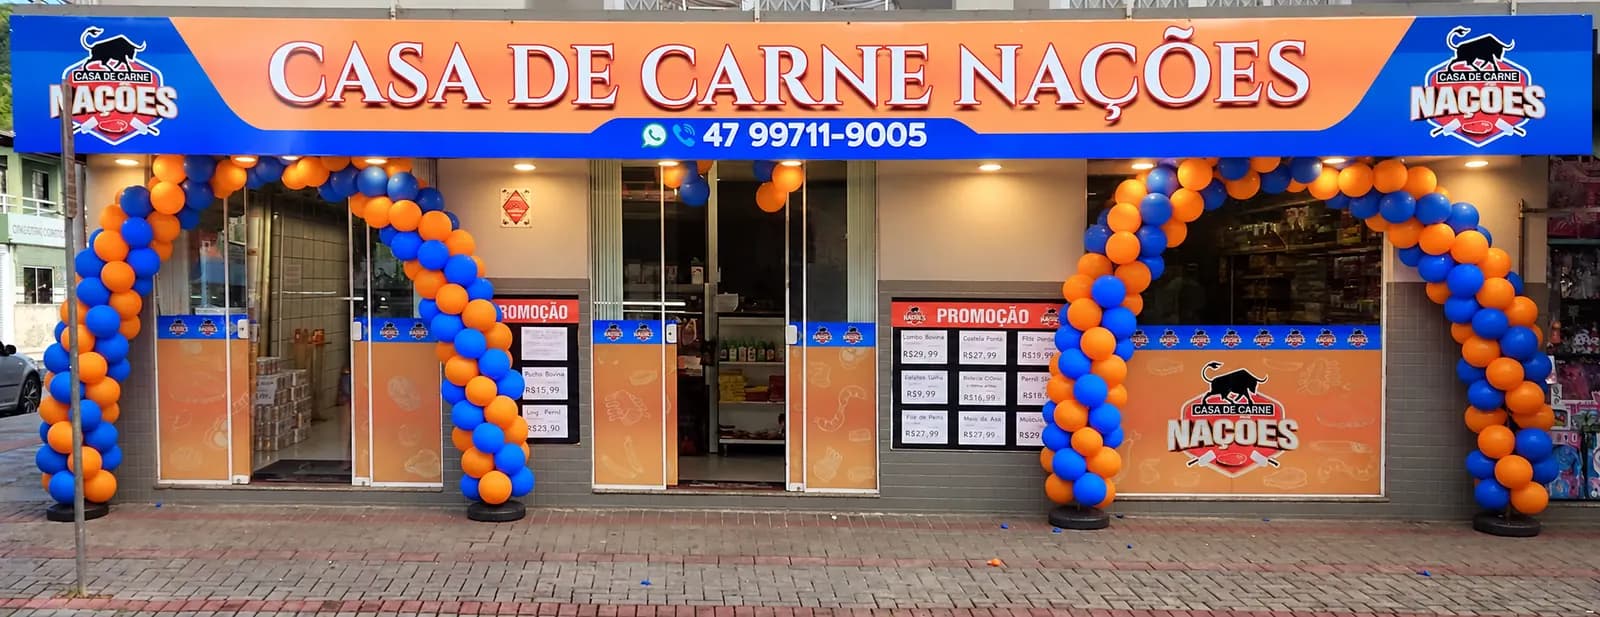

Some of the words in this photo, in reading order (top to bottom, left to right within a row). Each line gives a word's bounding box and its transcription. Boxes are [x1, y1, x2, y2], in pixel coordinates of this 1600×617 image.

[75, 72, 102, 81] CASA
[103, 72, 117, 81] DE
[117, 72, 150, 82] CARNE
[268, 40, 491, 105] CASA
[507, 43, 619, 106] DE
[640, 43, 933, 107] CARNE
[954, 25, 1310, 122] NAÇÕES
[1439, 72, 1466, 82] CASA
[1468, 72, 1482, 82] DE
[1483, 72, 1518, 82] CARNE
[1410, 82, 1546, 120] NAÇÕES
[702, 121, 739, 147] 47
[749, 121, 928, 148] 99711-9005
[498, 302, 568, 322] ROMOÇÃO
[937, 305, 1029, 327] PROMOÇÃO
[903, 350, 939, 359] R$29,99
[963, 351, 997, 360] R$27,99
[525, 386, 560, 395] R$15,99
[906, 390, 936, 399] R$9,99
[1194, 405, 1221, 415] CASA
[1223, 405, 1236, 415] DE
[1238, 405, 1272, 415] CARNE
[905, 430, 940, 438] R$27,99
[1019, 431, 1041, 440] R$29
[1167, 415, 1300, 451] NAÇÕES
